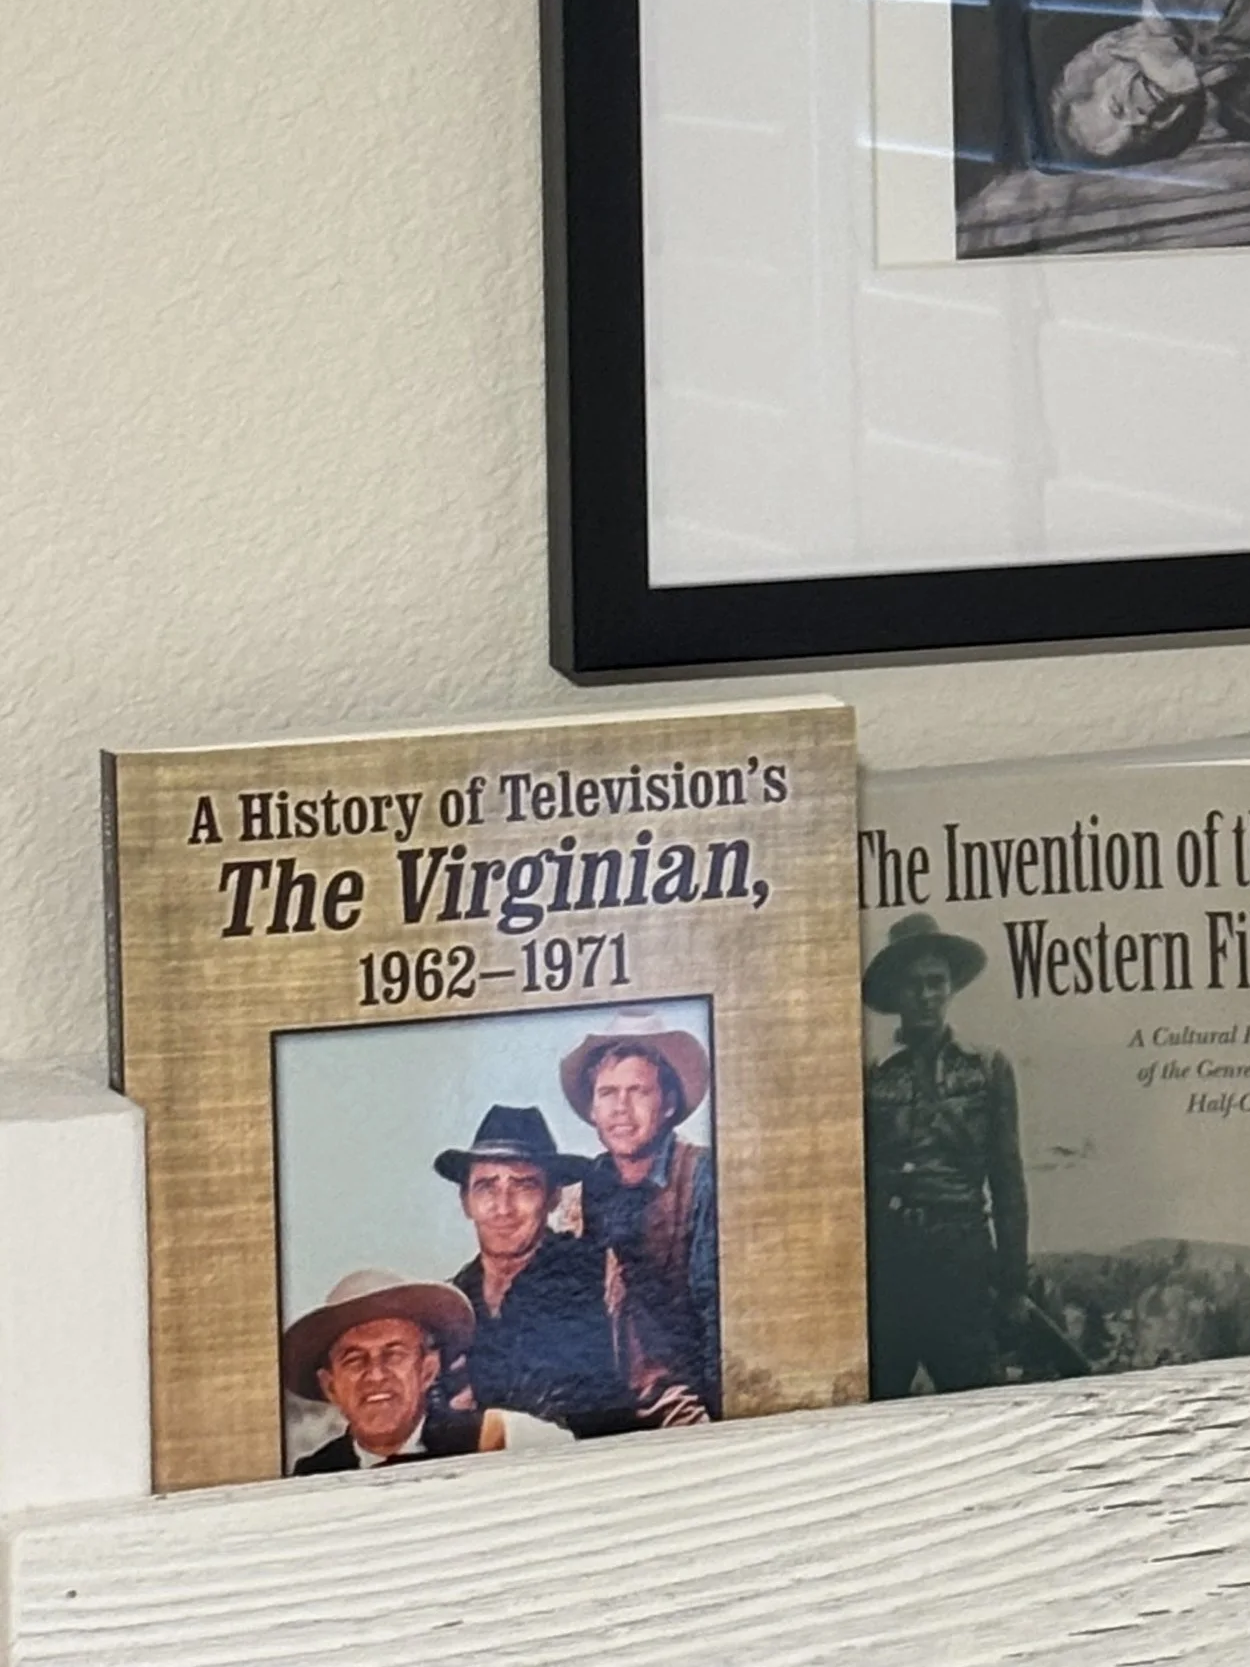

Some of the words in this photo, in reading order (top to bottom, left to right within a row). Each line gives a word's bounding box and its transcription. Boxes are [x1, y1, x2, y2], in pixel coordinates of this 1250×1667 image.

[187, 795, 223, 845] A
[239, 791, 423, 842] History
[440, 776, 487, 827] of
[500, 755, 789, 823] Television's
[218, 857, 364, 938] The
[396, 829, 772, 935] Virginian,
[943, 814, 1164, 902] Invention
[1176, 809, 1224, 889] of
[1003, 918, 1192, 1001] Western
[1127, 1028, 1145, 1048] A
[1152, 1024, 1239, 1048] Cultural
[1137, 1061, 1158, 1088] of
[1161, 1059, 1192, 1081] the
